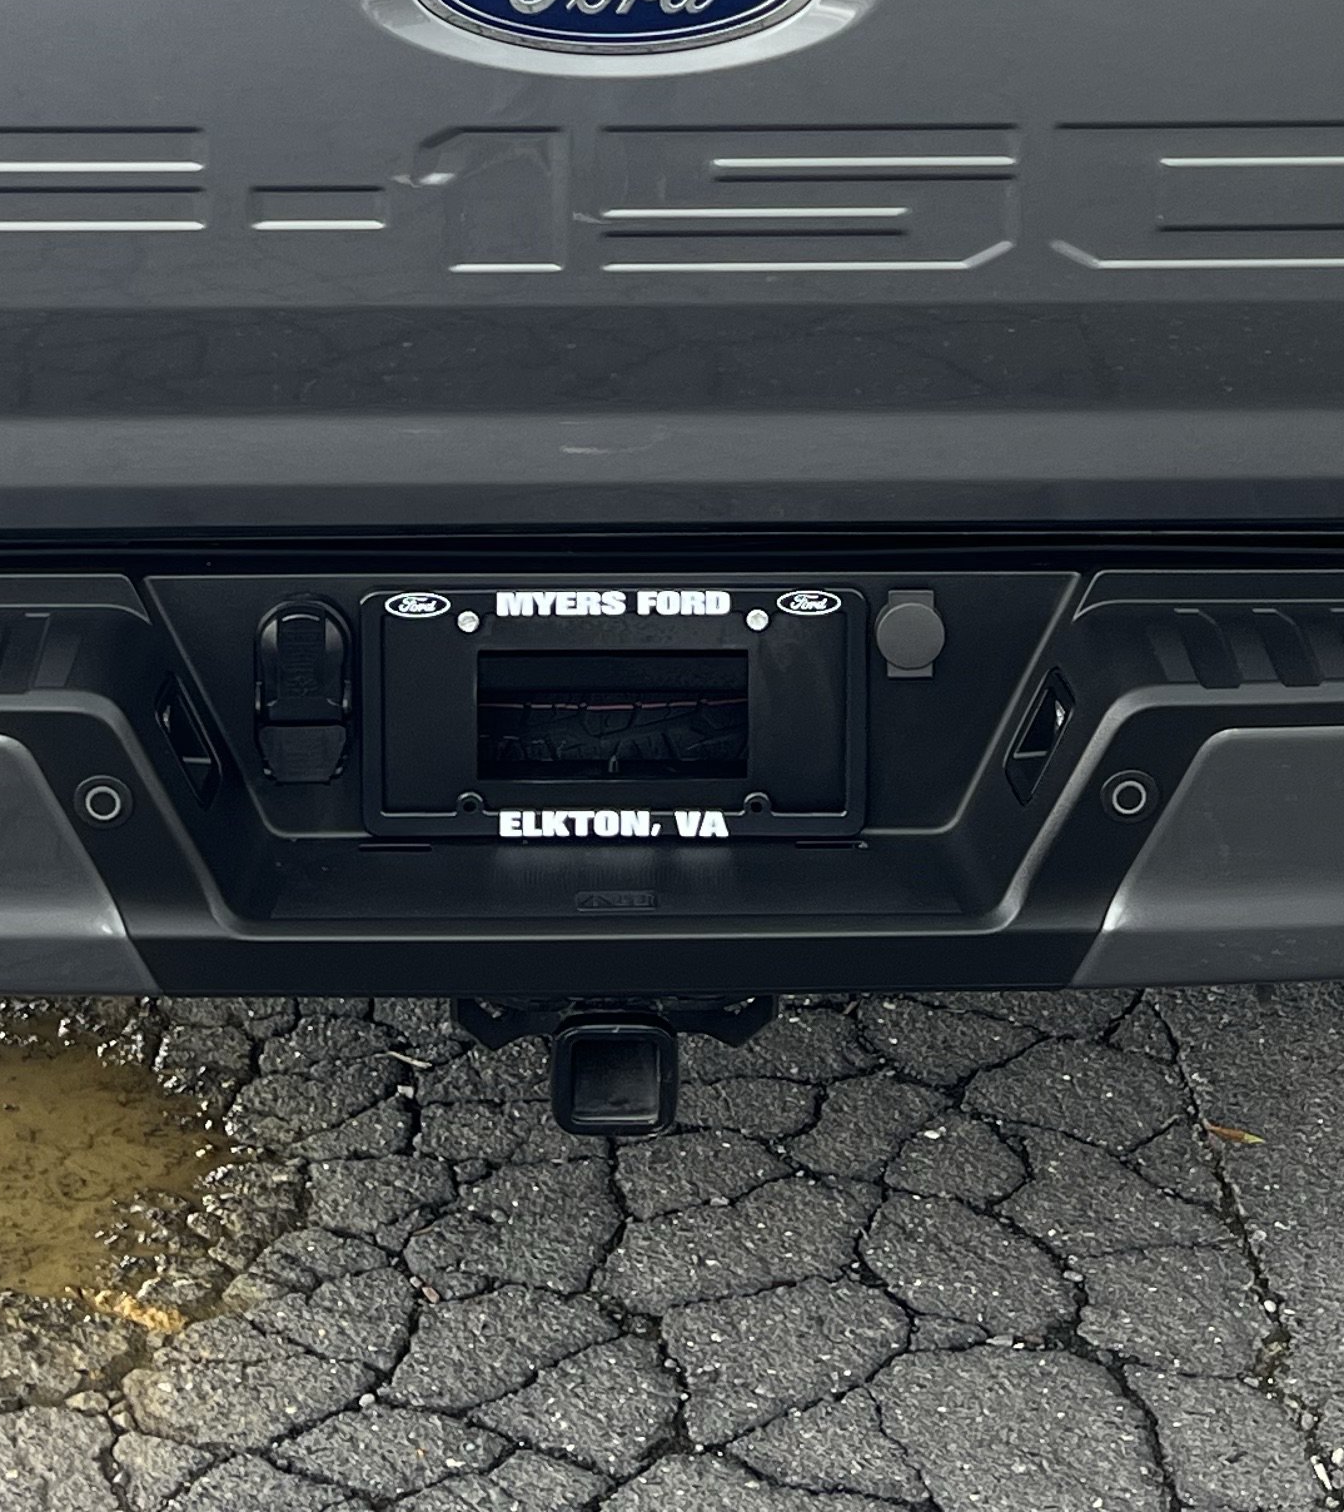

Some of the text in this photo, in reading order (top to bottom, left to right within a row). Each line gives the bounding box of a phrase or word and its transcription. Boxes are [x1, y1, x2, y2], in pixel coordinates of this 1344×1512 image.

[496, 590, 731, 617] MYERS FORD
[499, 810, 729, 838] ELKTON, VA
